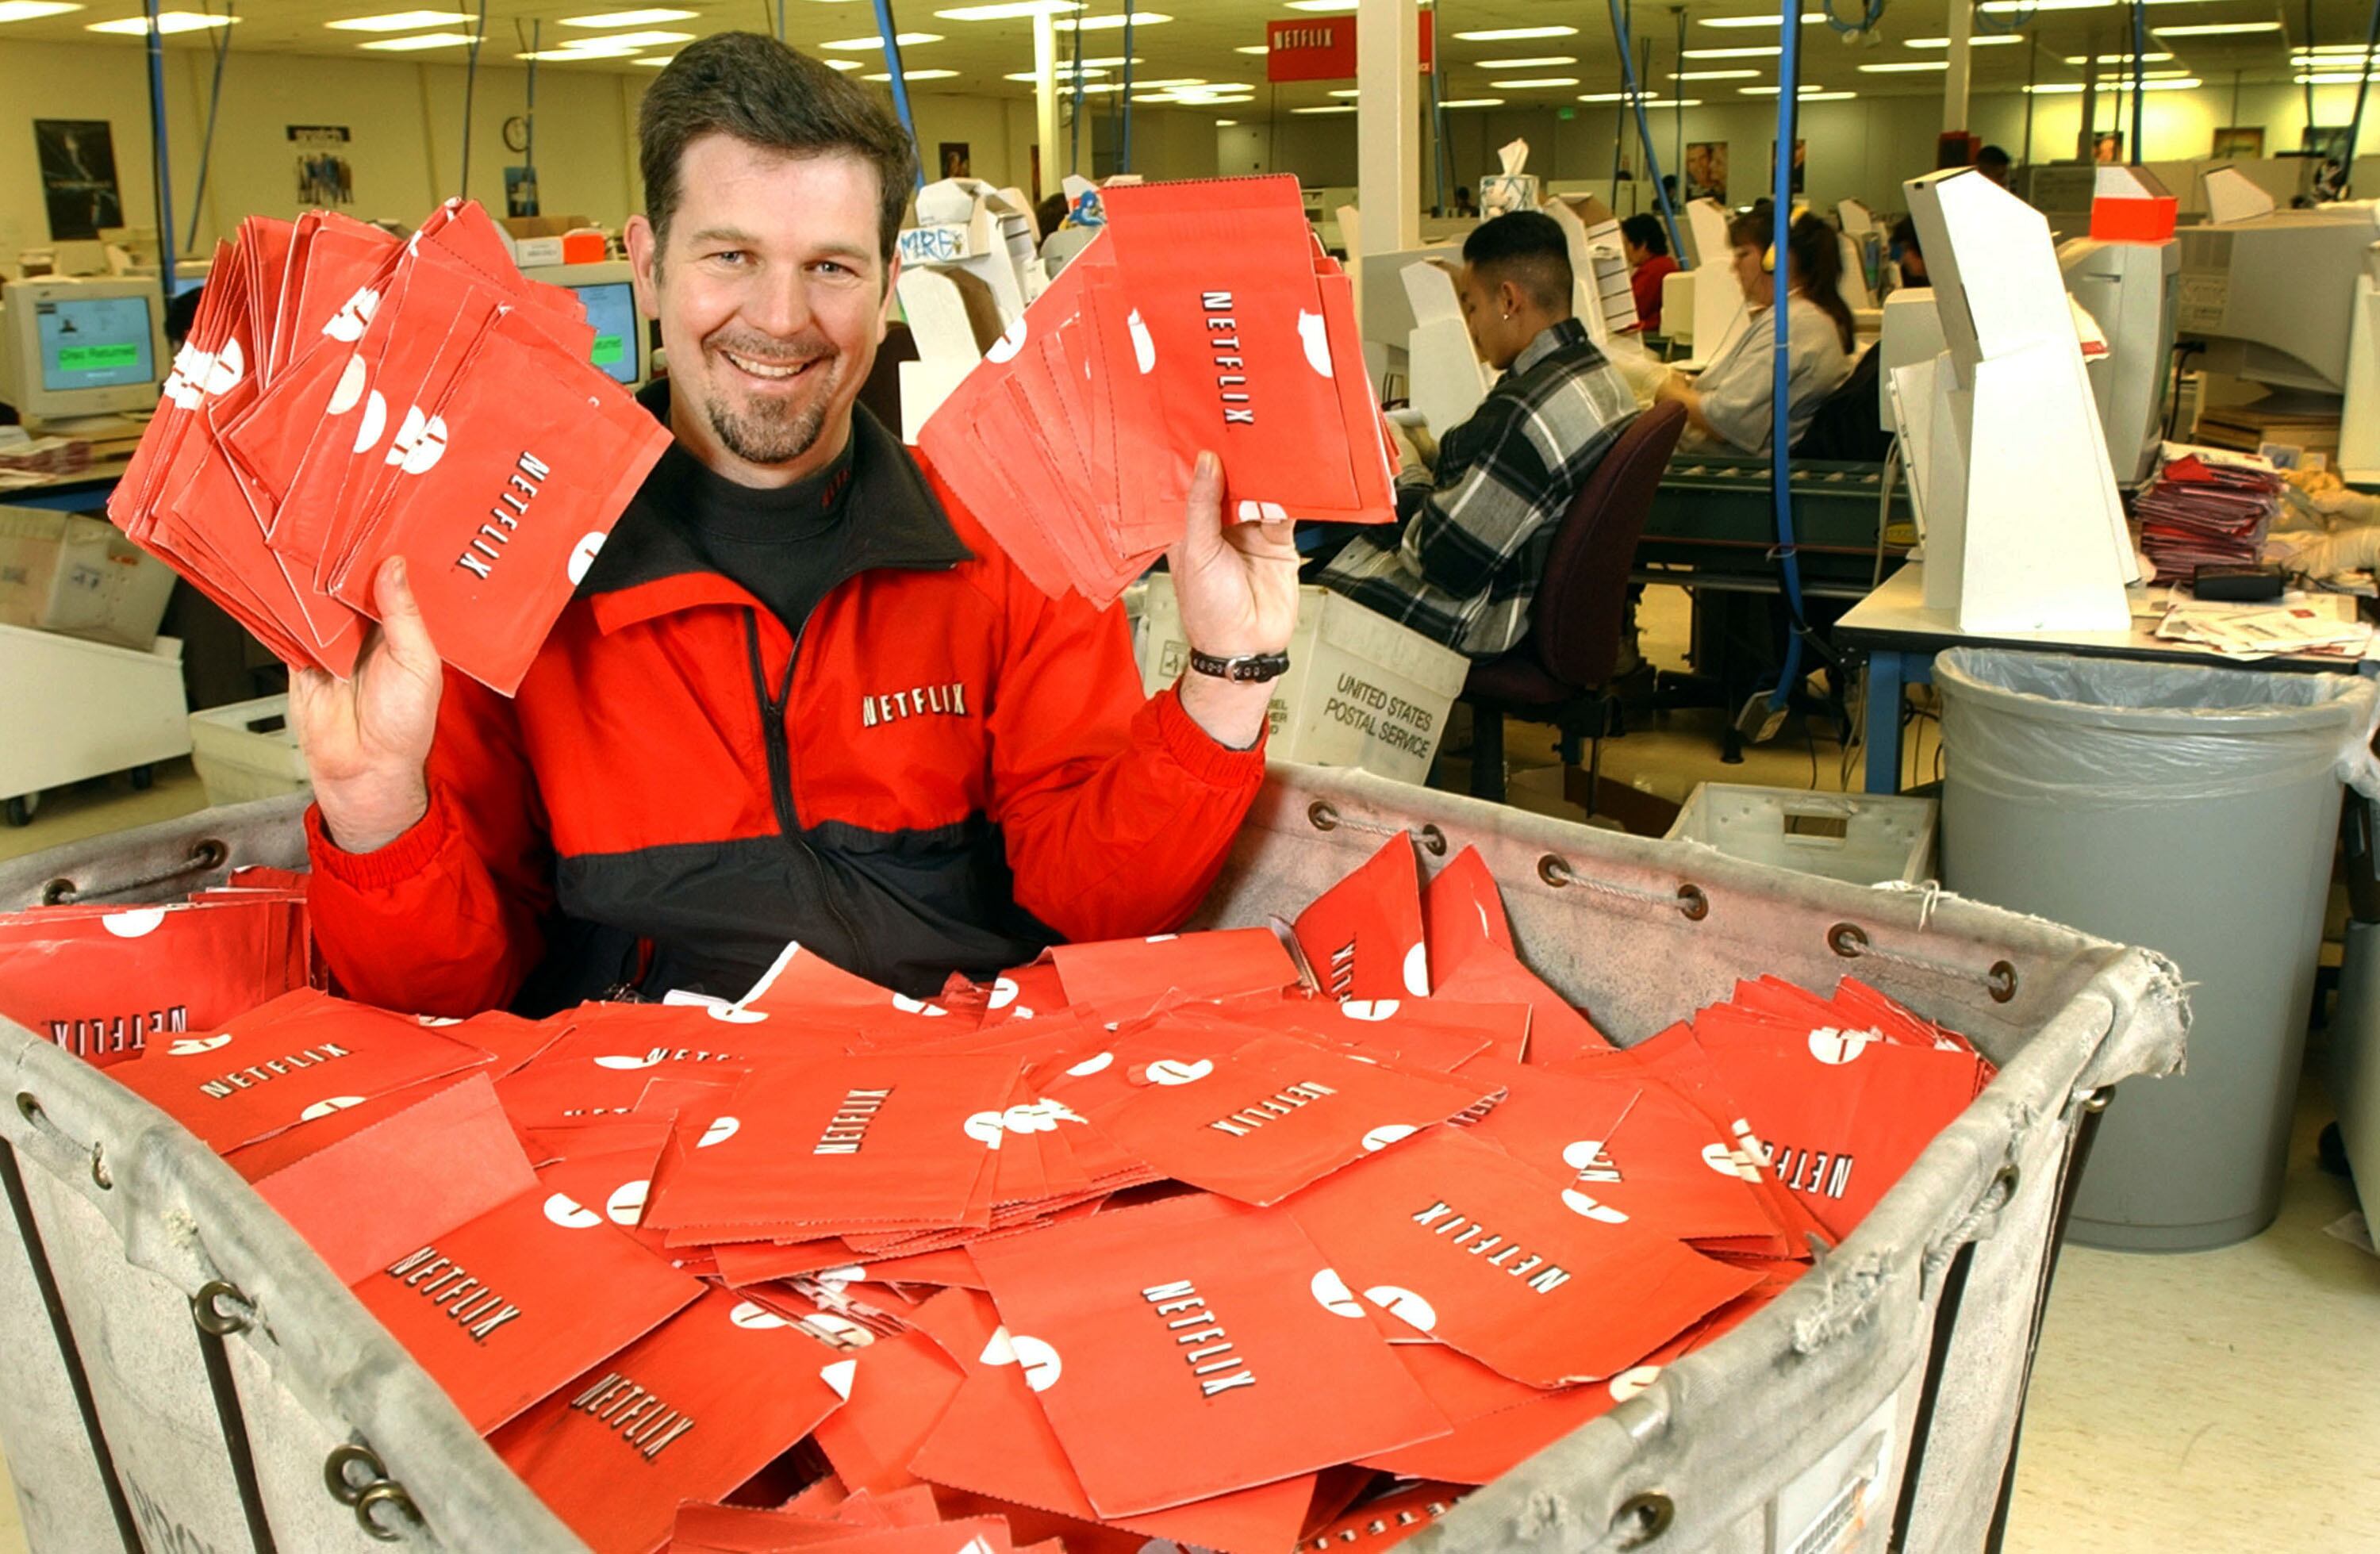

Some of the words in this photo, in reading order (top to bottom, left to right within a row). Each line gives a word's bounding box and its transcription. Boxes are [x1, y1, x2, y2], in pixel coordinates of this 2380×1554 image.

[1274, 28, 1334, 50] NETFLIX
[1201, 290, 1254, 425] NETFLIX
[455, 451, 550, 580] NETFLIX
[862, 683, 966, 727] NETFLIX
[1323, 696, 1376, 736] POSTAL
[1378, 721, 1430, 759] SERVICE
[1337, 672, 1388, 710] UNITED
[1388, 696, 1433, 732] STATES
[51, 1005, 187, 1057] NETFLIX
[199, 1043, 351, 1099] NETFLIX
[813, 1088, 895, 1154] NETFLIX
[1207, 1081, 1338, 1137] NETFLIX
[1412, 1200, 1571, 1294] NETFLIX
[386, 1245, 520, 1341] NETFLIX
[1142, 1280, 1256, 1398] NETFLIX
[570, 1372, 694, 1460] NETFLIX
[1298, 1498, 1458, 1552] ETFLI
